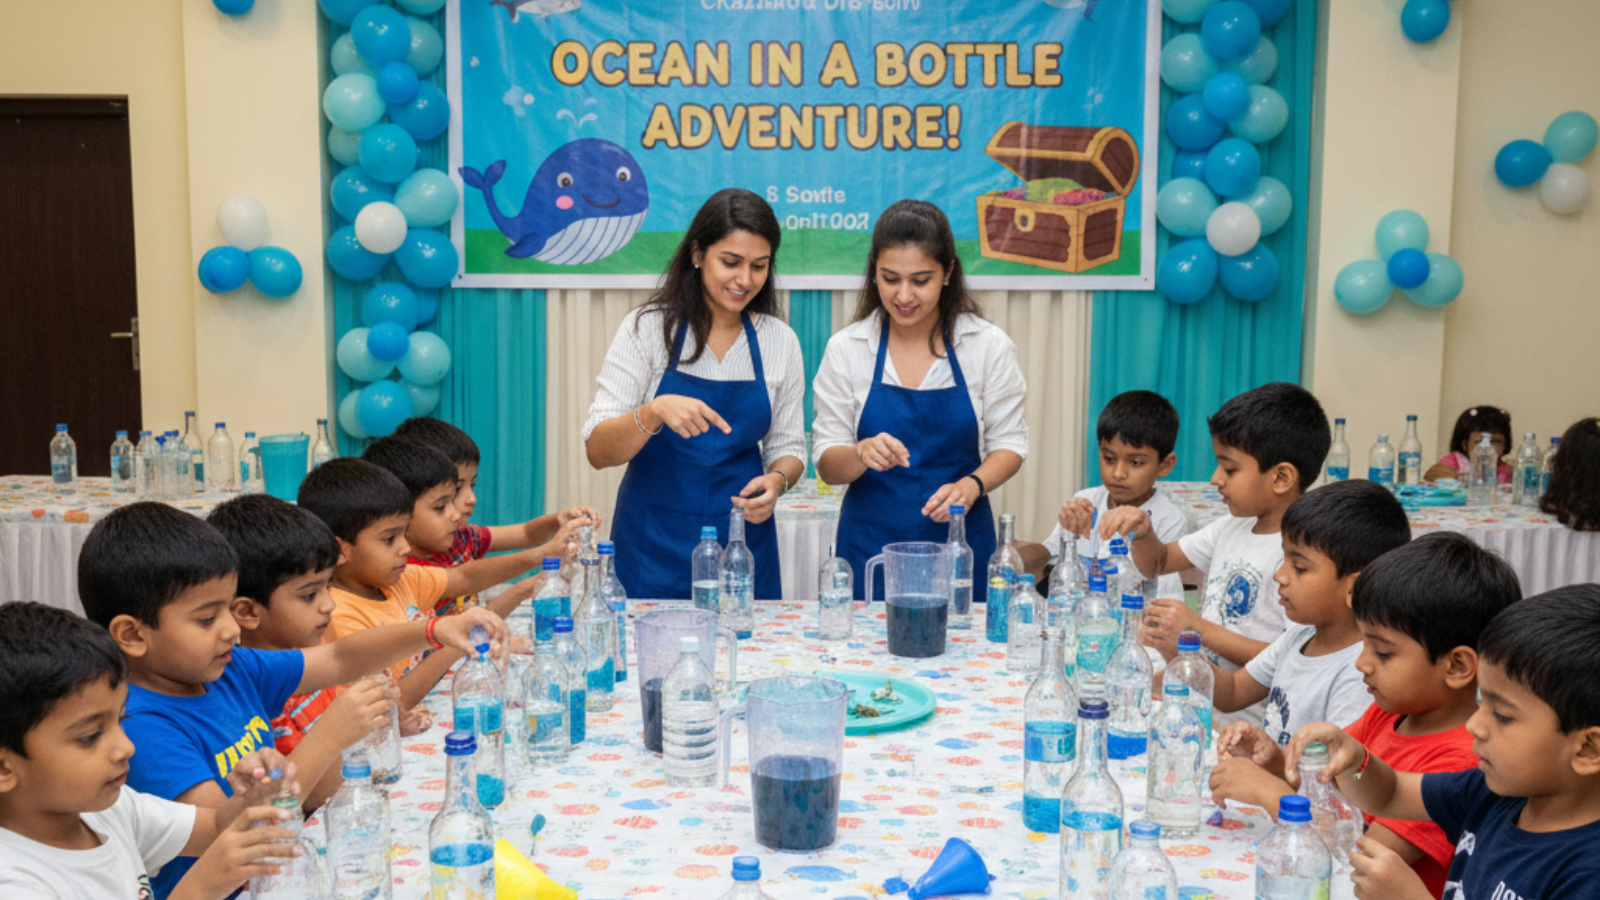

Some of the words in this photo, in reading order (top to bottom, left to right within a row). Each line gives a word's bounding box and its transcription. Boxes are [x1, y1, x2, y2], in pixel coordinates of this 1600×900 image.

[551, 40, 731, 87] OCEAN
[749, 40, 804, 87] IN
[819, 40, 859, 87] A
[874, 41, 1063, 88] BOTTLE
[641, 103, 962, 150] ADVENTURE!
